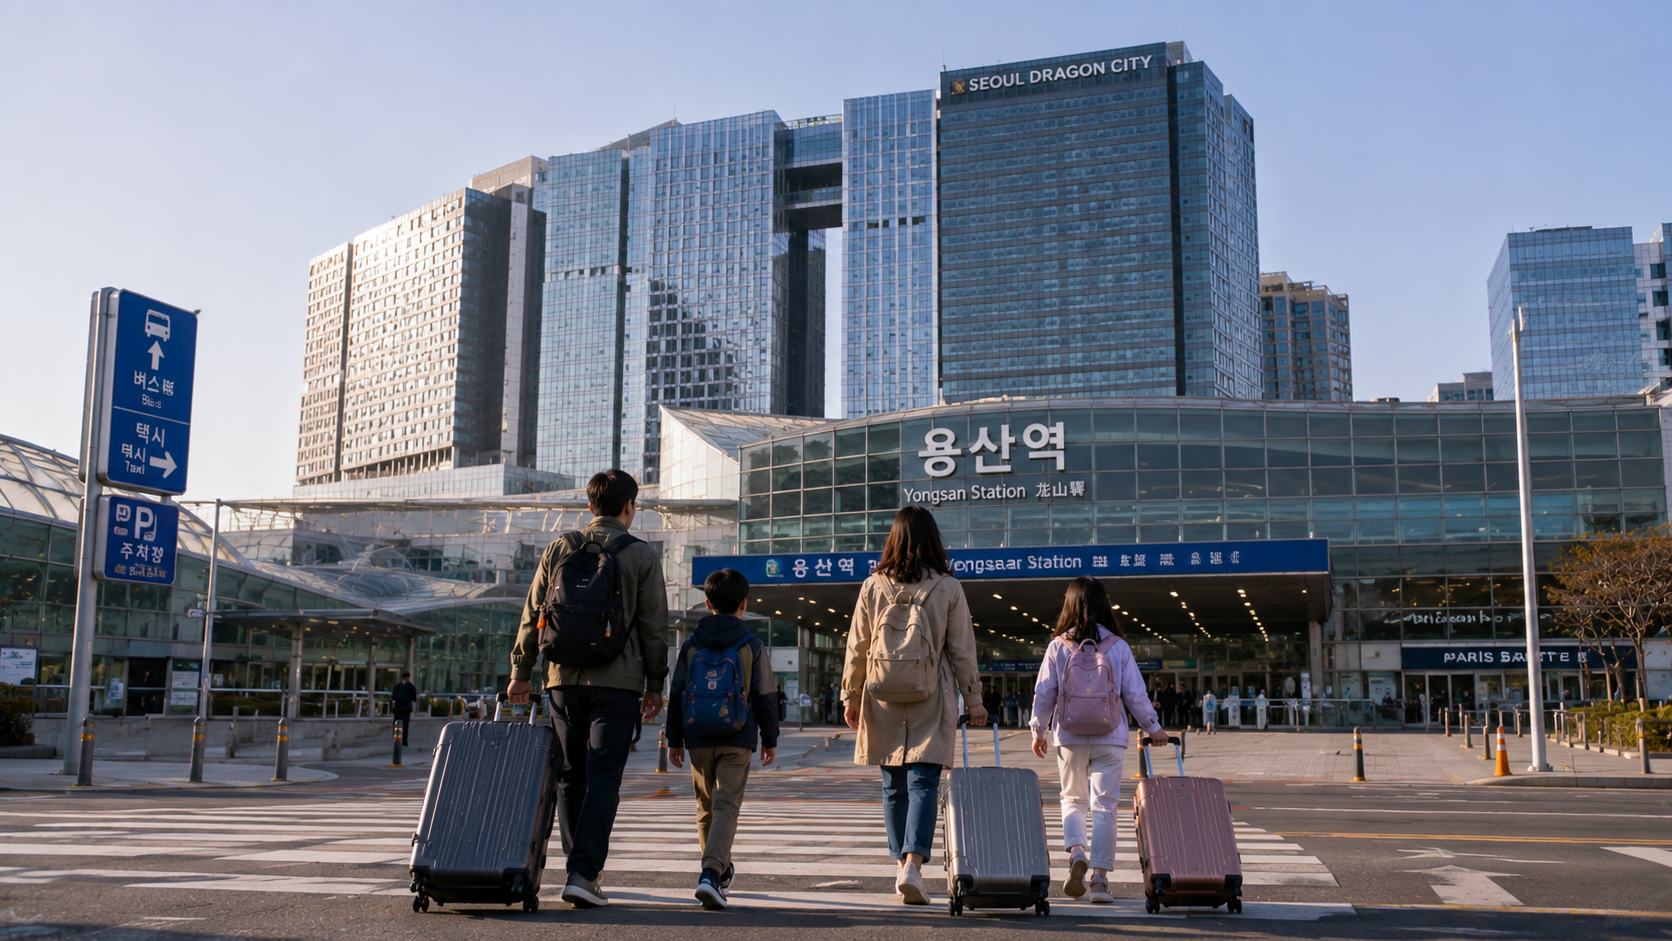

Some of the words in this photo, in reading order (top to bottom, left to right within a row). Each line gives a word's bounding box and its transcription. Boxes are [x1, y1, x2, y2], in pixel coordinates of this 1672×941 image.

[969, 72, 1025, 92] SEOUL
[1030, 61, 1106, 85] DRAGON
[1111, 55, 1152, 74] CITY
[136, 422, 165, 448] 택시
[918, 421, 1065, 478] 용산역
[903, 487, 967, 505] Yongsan
[971, 483, 1026, 500] Station
[792, 557, 855, 578] 용산역
[1027, 554, 1082, 570] Station
[1444, 651, 1494, 663] PARIS
